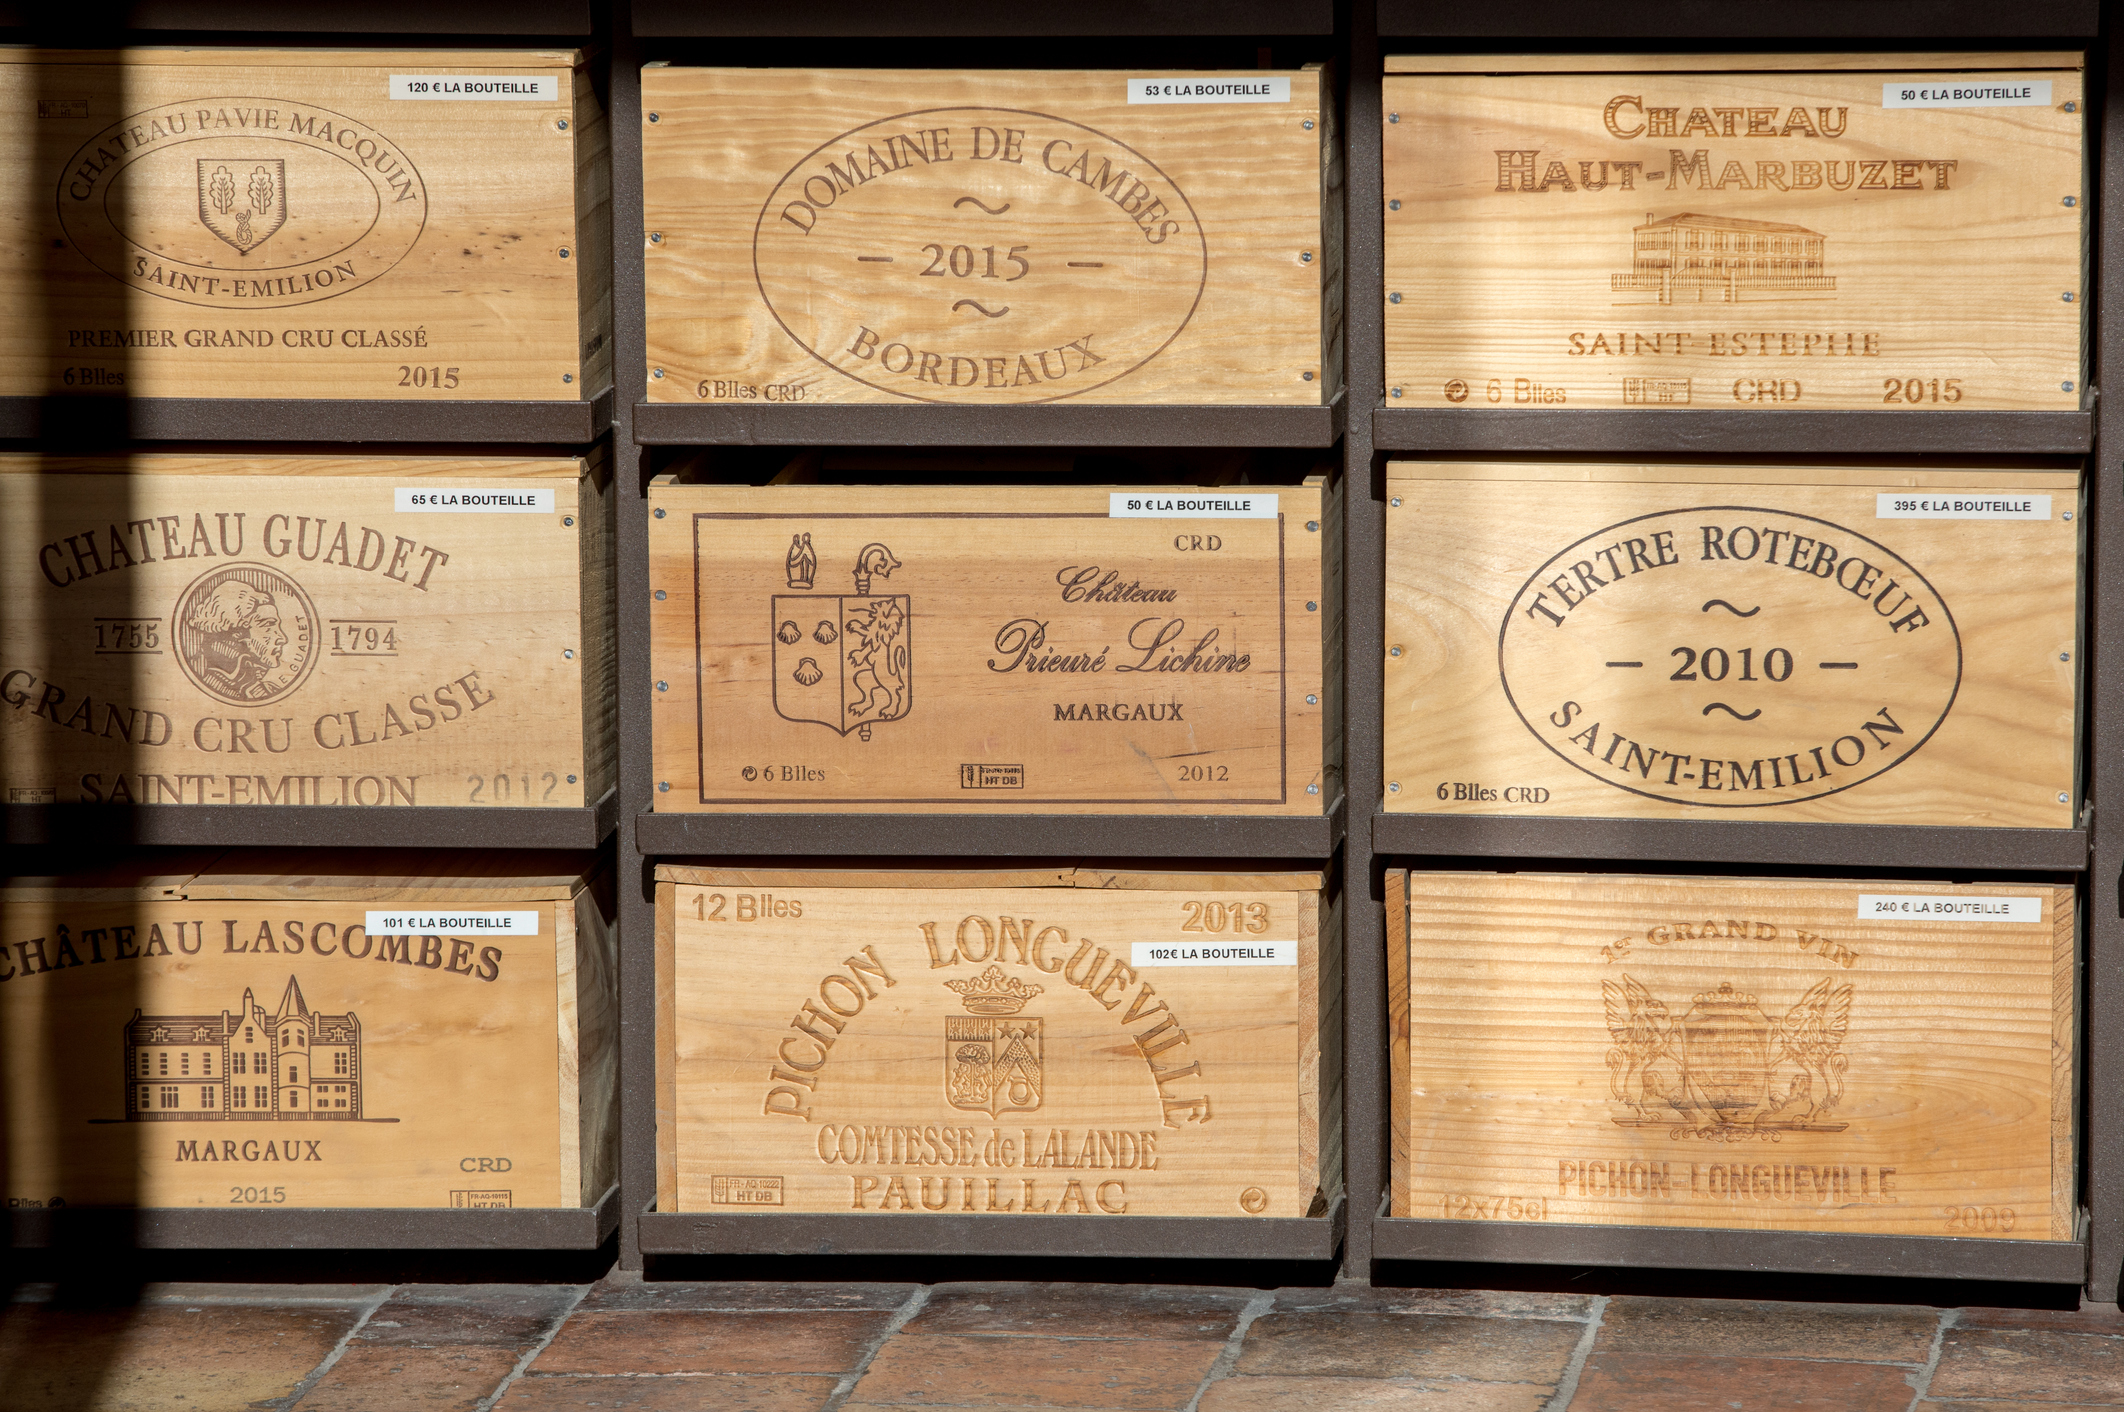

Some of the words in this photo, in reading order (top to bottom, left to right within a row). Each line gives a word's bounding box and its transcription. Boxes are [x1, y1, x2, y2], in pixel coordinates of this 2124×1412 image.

[408, 82, 428, 93] 120
[432, 82, 440, 92] €
[444, 82, 461, 93] LA
[464, 83, 539, 94] BOUTEILLE
[1145, 85, 1160, 96] 53
[1163, 85, 1172, 96] €
[1175, 85, 1192, 96] LA
[1195, 84, 1270, 95] BOUTEILLE
[1901, 89, 1916, 101] 50
[1920, 89, 1929, 101] €
[1932, 88, 1950, 100] LA
[1953, 87, 2032, 100] BOUTEILLE
[1603, 95, 1849, 140] CHATEAU
[70, 113, 187, 201] CHATEAU
[195, 107, 280, 131] PAVIE
[288, 112, 417, 203] MACQUIN
[1494, 149, 1959, 193] HAUT-MARBUZET
[780, 127, 953, 236] DOMAINE
[970, 126, 1026, 165] DE
[1042, 139, 1181, 246] CAMBES
[133, 256, 356, 298] SAINT-EMILION
[919, 244, 1030, 282] 2015
[67, 329, 178, 348] PREMIER
[183, 329, 274, 348] GRAND
[281, 329, 333, 348] CRU
[340, 325, 428, 348] CLASSÉ
[1567, 332, 1880, 357] SAINT-ESTEPHE
[846, 325, 1107, 389] BORDEAUX
[63, 367, 75, 386] 6
[79, 367, 125, 386] Blles
[397, 365, 460, 390] 2015
[697, 379, 709, 400] 6
[714, 380, 757, 400] Blles
[764, 384, 806, 402] CRD
[1486, 378, 1502, 404] 6
[1513, 377, 1567, 404] Blles
[1732, 378, 1801, 404] CRD
[1882, 378, 1963, 404] 2015
[411, 494, 426, 506] 65
[429, 495, 438, 505] €
[441, 495, 458, 506] LA
[462, 495, 536, 506] BOUTEILLE
[1127, 500, 1141, 510] 50
[1145, 500, 1153, 510] €
[1157, 500, 1173, 511] LA
[1177, 500, 1251, 511] BOUTEILLE
[1894, 501, 1917, 511] 395
[1921, 501, 1929, 511] €
[1933, 501, 1950, 511] LA
[1954, 501, 2032, 512] BOUTEILLE
[38, 512, 246, 588] CHATEAU
[262, 513, 450, 593] GUADET
[1173, 534, 1222, 551] CRD
[1056, 565, 1178, 603] Château
[1525, 530, 1680, 629] TERTRE
[1699, 525, 1931, 634] ROTEBŒUF
[94, 623, 160, 649] 1755
[331, 626, 398, 651] 1794
[289, 615, 309, 672] GUADET
[987, 618, 1110, 673] Prieuré
[1115, 617, 1251, 673] Lichine
[1669, 646, 1794, 682] 2010
[0, 669, 173, 747] GRAND
[193, 717, 294, 754] CRU
[313, 670, 496, 750] CLASSE
[1053, 703, 1184, 721] MARGAUX
[1549, 700, 1905, 792] SAINT-EMILION
[79, 773, 420, 806] SAINT-EMILION
[467, 771, 560, 804] 2012
[763, 765, 774, 782] 6
[780, 764, 826, 782] Blles
[1178, 765, 1229, 782] 2012
[1436, 782, 1449, 800] 6
[1453, 782, 1497, 801] Blles
[1503, 786, 1550, 804] CRD
[383, 917, 403, 928] 101
[407, 917, 416, 928] €
[419, 917, 436, 928] LA
[439, 917, 512, 928] BOUTEILLE
[692, 893, 727, 922] 12
[736, 893, 803, 922] Blles
[1181, 900, 1269, 934] 2013
[1875, 902, 1897, 912] 240
[1901, 902, 1910, 912] €
[1913, 903, 1930, 913] LA
[1934, 903, 2010, 914] BOUTEILLE
[221, 919, 503, 983] LASCOMBES
[1149, 949, 1178, 960] 102€
[1182, 949, 1198, 960] LA
[1202, 948, 1275, 959] BOUTEILLE
[1600, 936, 1632, 965] 1er
[1646, 919, 1778, 946] GRAND
[1795, 929, 1860, 970] VIN
[761, 944, 897, 1123] PICHON
[919, 915, 1213, 1130] LONGUEVILLE
[175, 1139, 323, 1162] MARGAUX
[817, 1123, 977, 1168] COMTESSE
[983, 1127, 1015, 1168] de
[1022, 1127, 1160, 1171] LALANDE
[459, 1157, 513, 1173] CRD
[1558, 1159, 1898, 1204] PICHON-LONGUEVILLE
[229, 1186, 286, 1204] 2015
[736, 1190, 753, 1201] HT
[755, 1190, 773, 1202] DB
[851, 1175, 1129, 1214] PAUILLAC
[1438, 1193, 1549, 1221] 12x75cl
[1943, 1205, 2016, 1233] 2009
